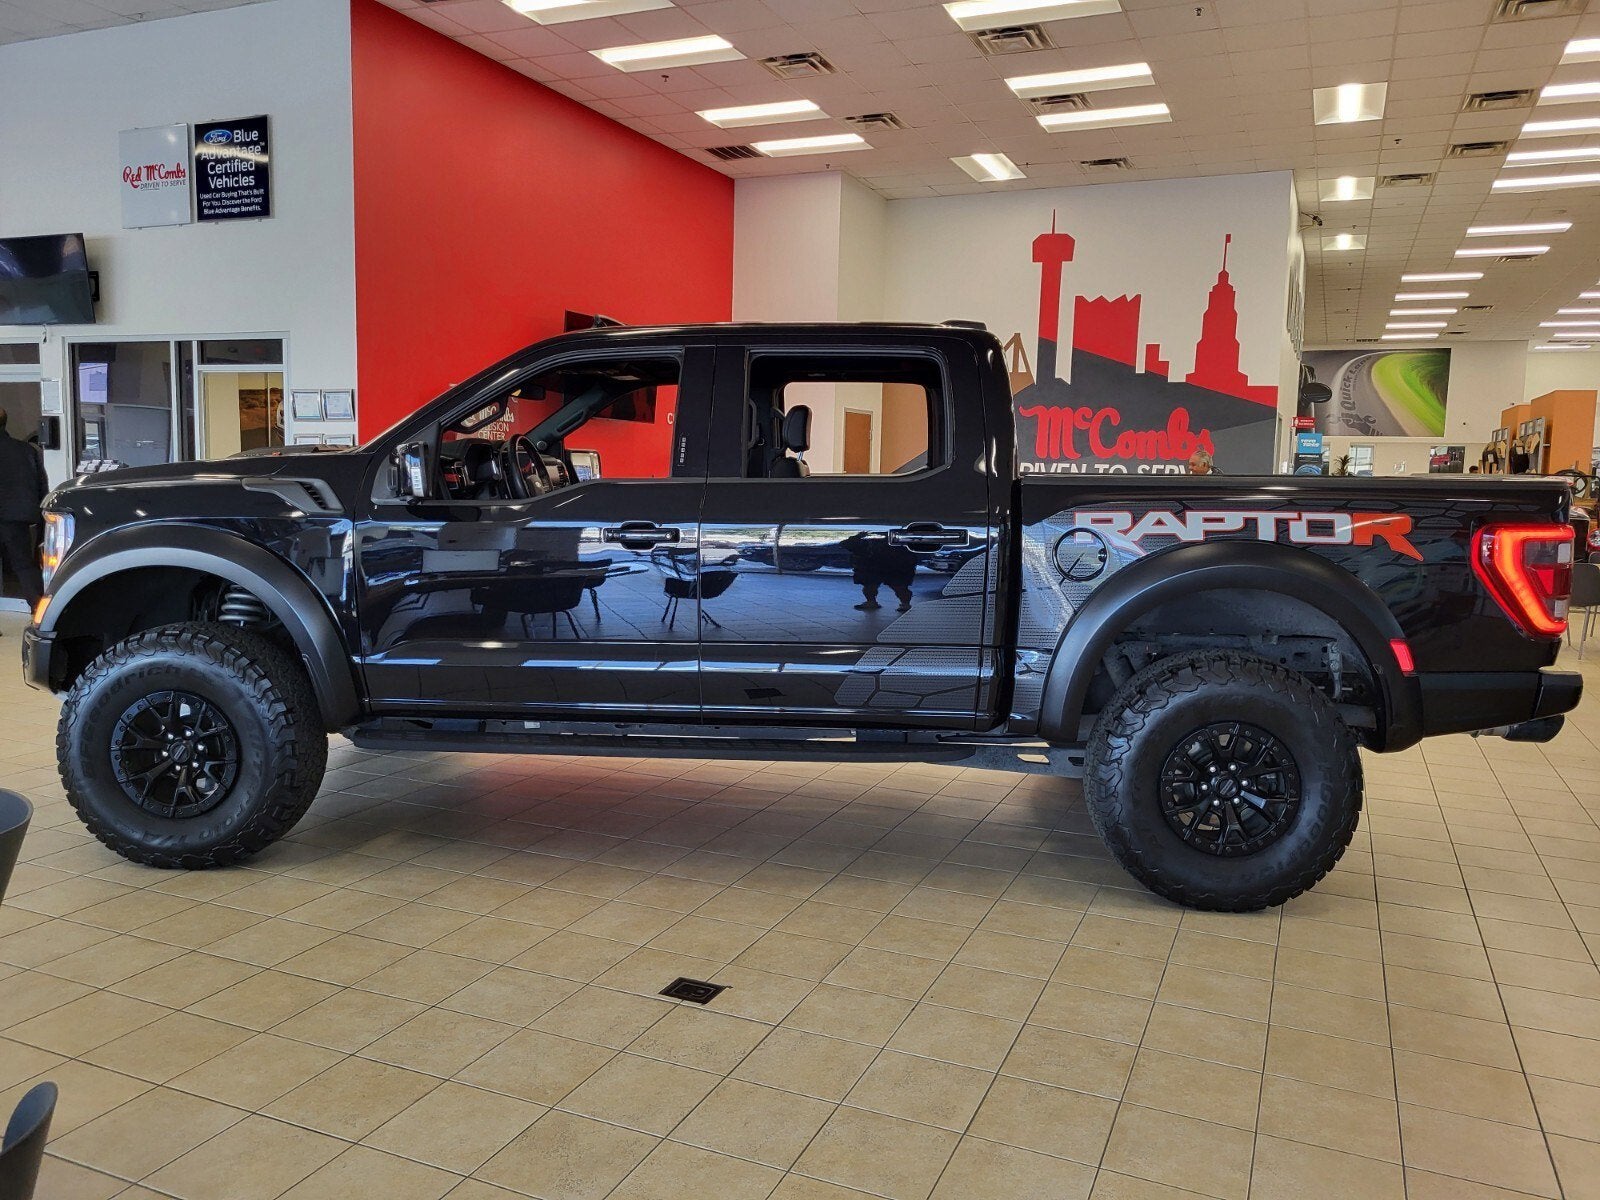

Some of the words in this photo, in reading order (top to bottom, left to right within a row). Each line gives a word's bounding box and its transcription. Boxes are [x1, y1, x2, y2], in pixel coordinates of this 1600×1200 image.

[233, 129, 259, 143] Blue
[208, 159, 255, 174] Certified
[123, 166, 142, 189] Red
[143, 162, 186, 181] McCombs
[209, 174, 255, 189] Vehicles
[140, 182, 160, 190] DRIVEN
[170, 179, 186, 187] SERVE
[477, 430, 506, 440] CENTER
[1019, 405, 1214, 460] McCombs
[1094, 463, 1128, 474] TO
[1137, 464, 1193, 474] SERV
[1074, 510, 1424, 562] RAPTOR
